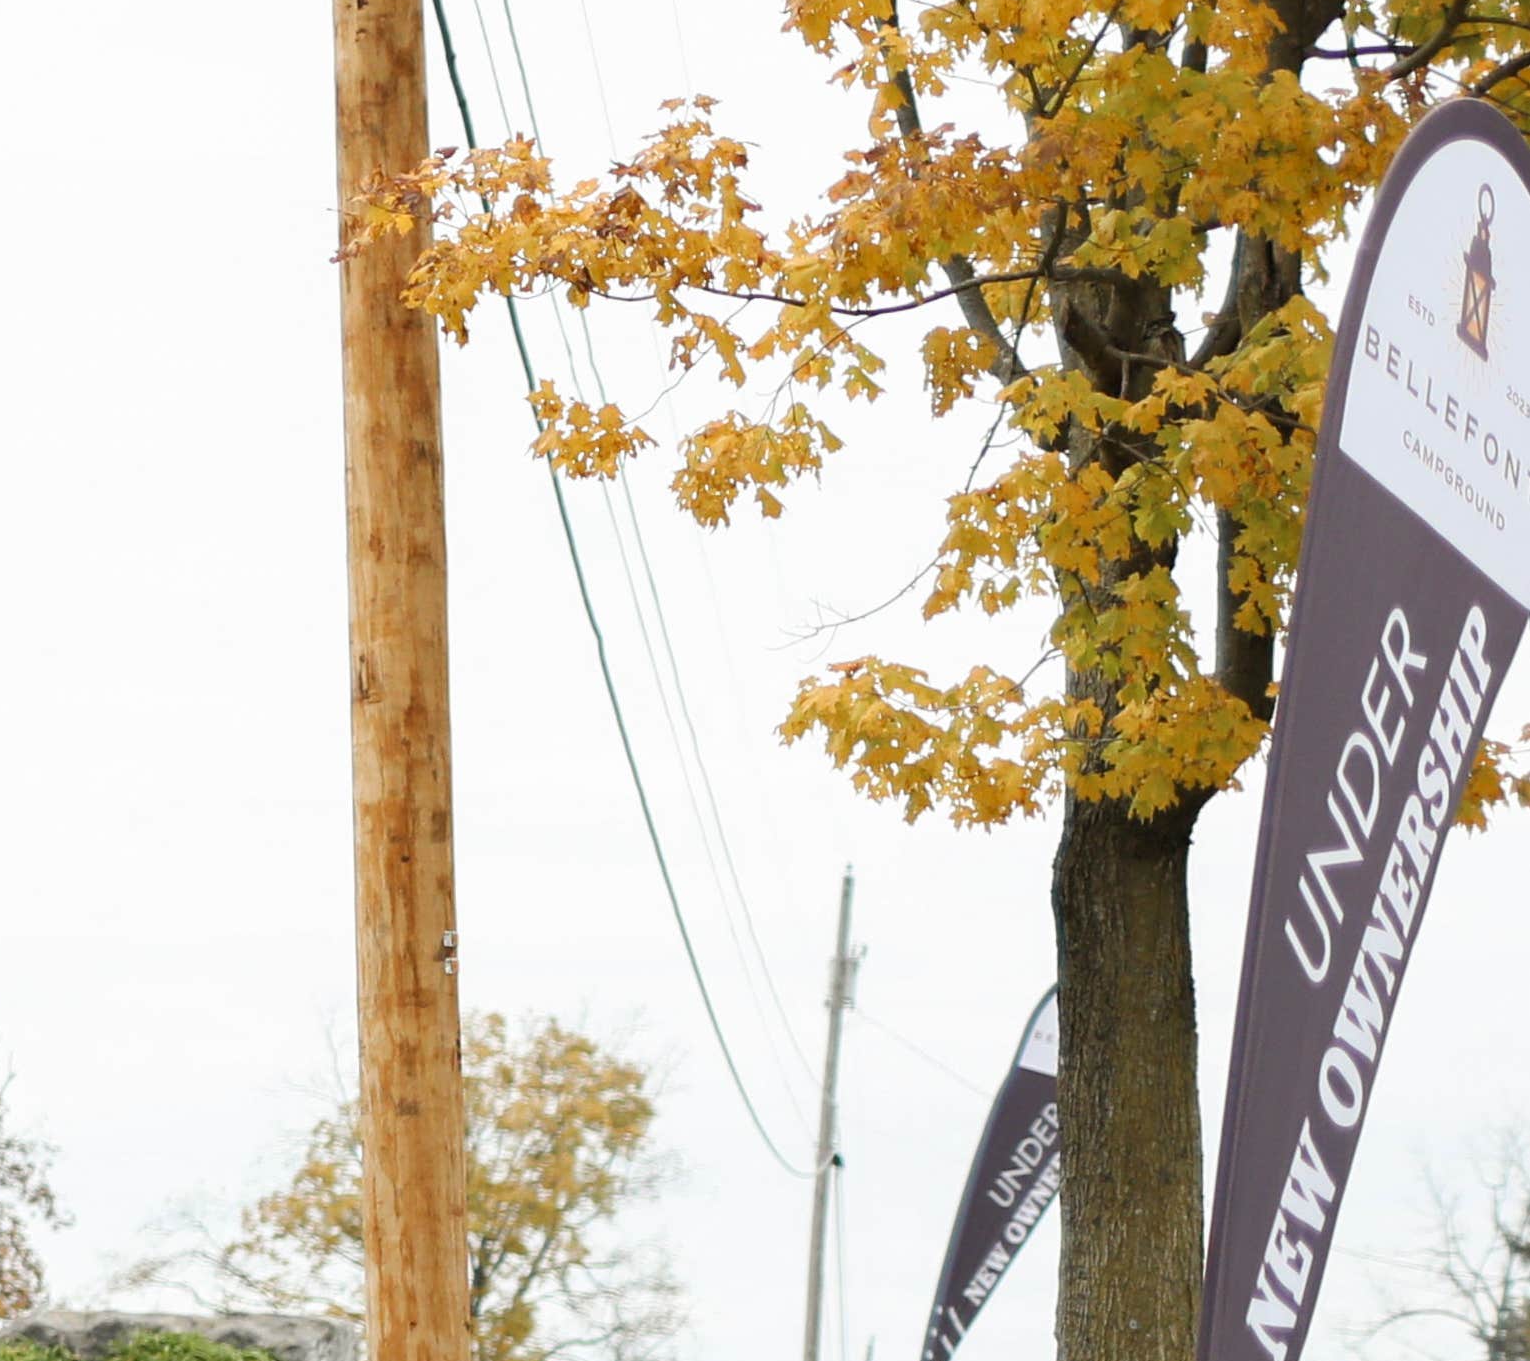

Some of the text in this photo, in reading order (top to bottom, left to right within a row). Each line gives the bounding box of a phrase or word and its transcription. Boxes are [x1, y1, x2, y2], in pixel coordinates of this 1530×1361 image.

[1408, 295, 1436, 327] ESTD
[1364, 324, 1530, 491] BELLEFON
[1402, 429, 1505, 532] CAMPGROUND
[1284, 607, 1427, 983] UNDER
[1318, 605, 1492, 1128] OWNERSHIP
[963, 1241, 1010, 1307] NEW
